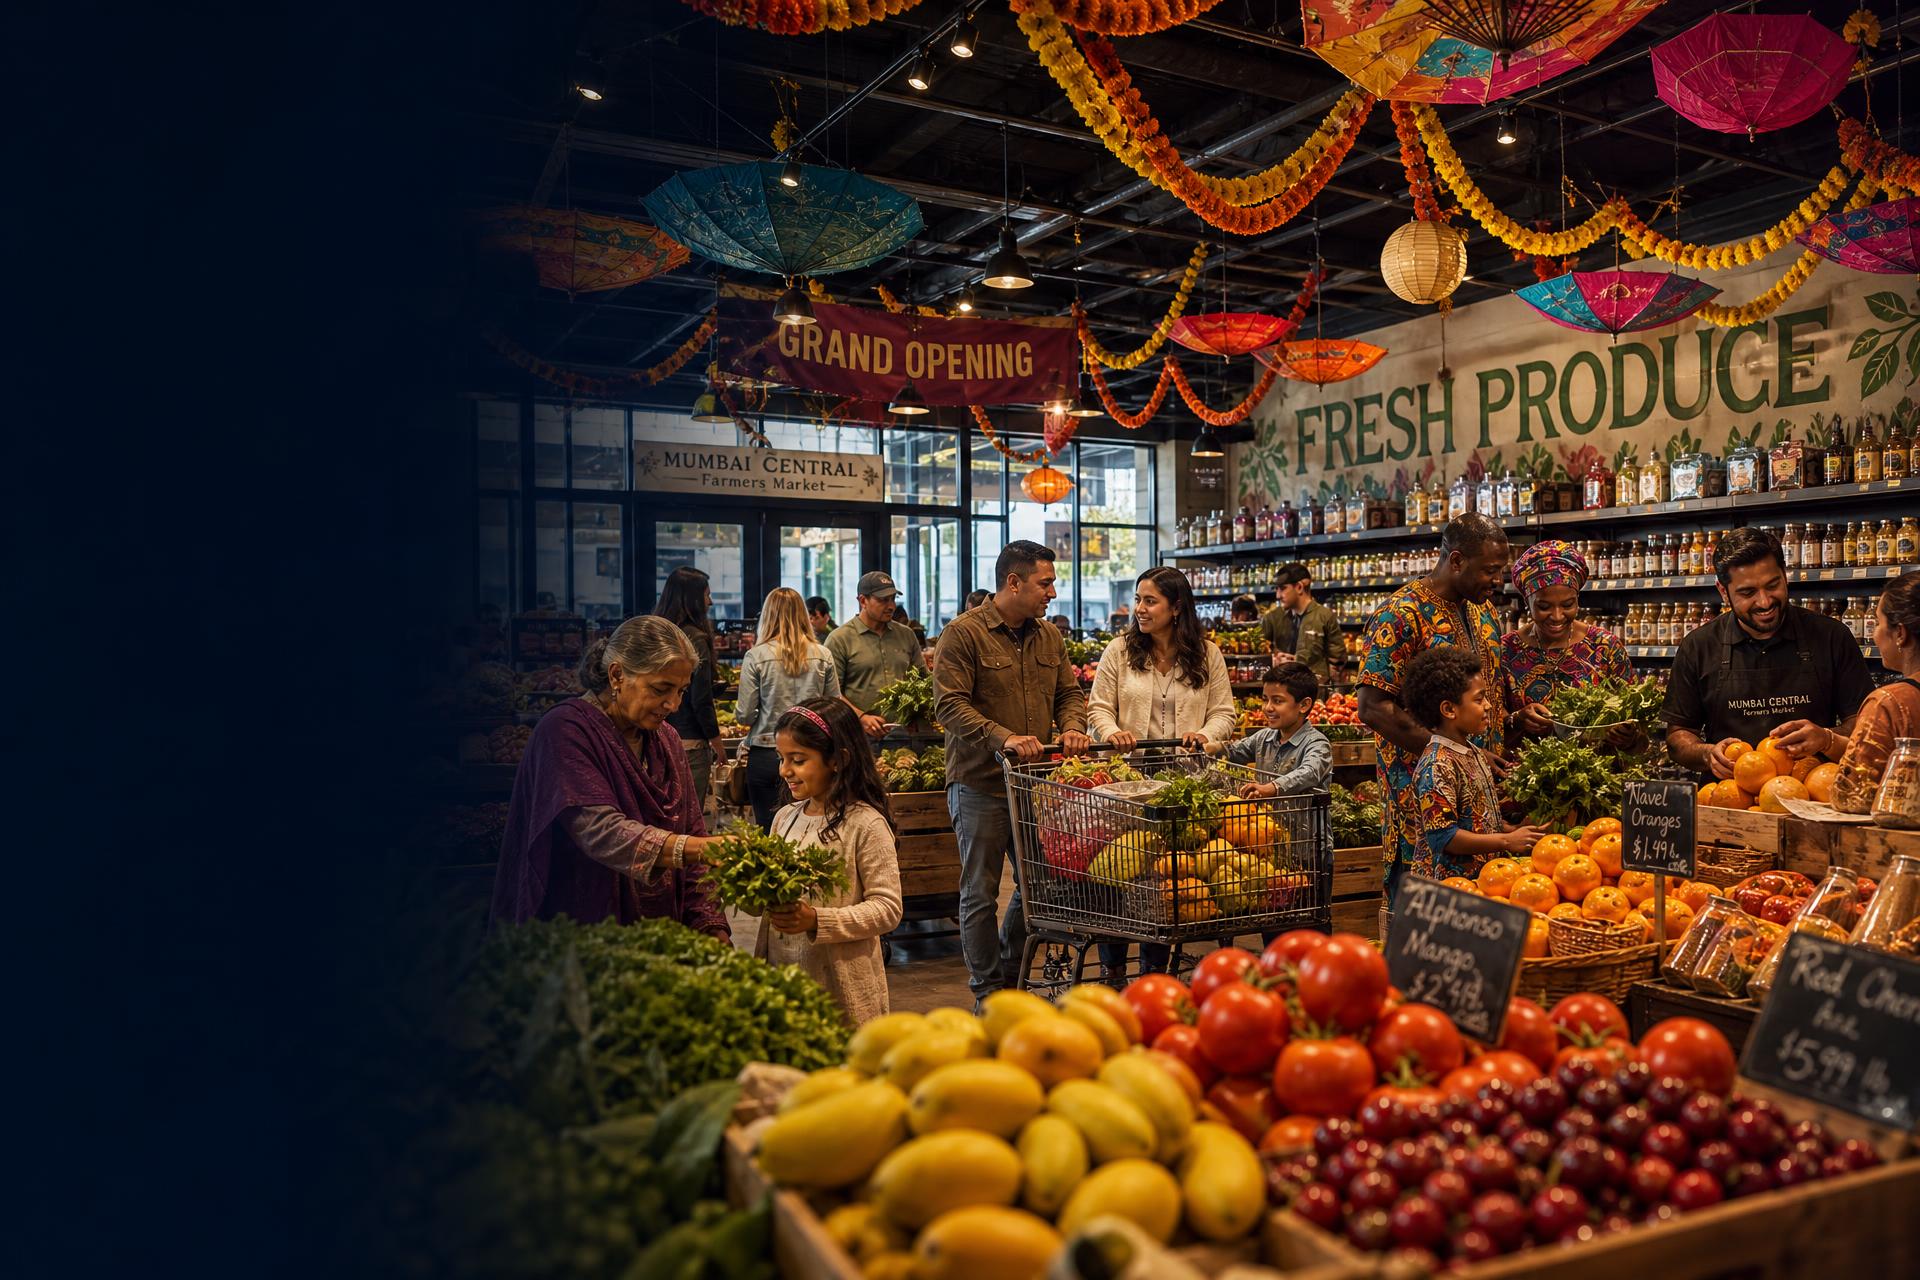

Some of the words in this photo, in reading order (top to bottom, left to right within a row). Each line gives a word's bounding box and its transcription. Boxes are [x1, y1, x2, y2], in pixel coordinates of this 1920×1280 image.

[778, 322, 893, 375] GRAND
[905, 341, 1033, 380] OPENING
[1295, 378, 1456, 476] FRESH
[1476, 306, 1832, 448] PRODUCE
[664, 451, 751, 472] MUMBAI
[763, 456, 858, 477] CENTRAL
[702, 473, 766, 489] Farmers
[773, 476, 825, 492] Market
[1728, 699, 1766, 709] MUMBAI
[1768, 695, 1812, 707] CENTRAL
[1628, 783, 1668, 806] Navel
[1631, 807, 1681, 837] Oranges
[1404, 888, 1504, 940] Alphonso
